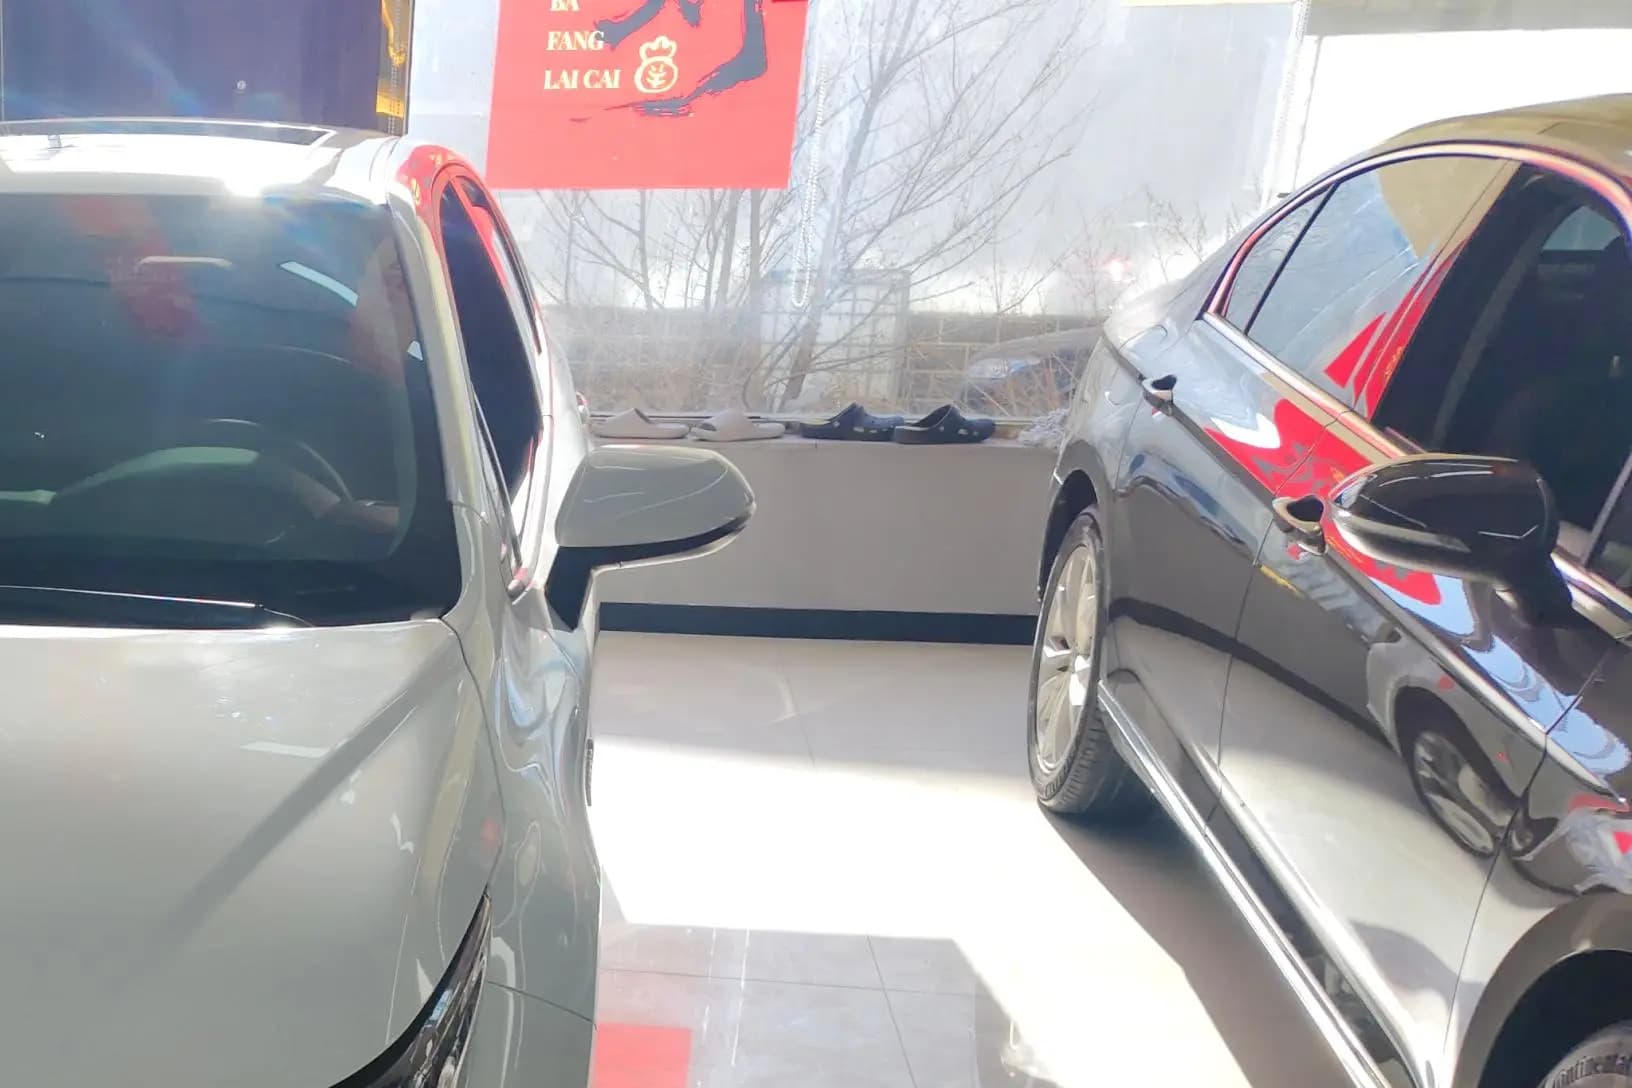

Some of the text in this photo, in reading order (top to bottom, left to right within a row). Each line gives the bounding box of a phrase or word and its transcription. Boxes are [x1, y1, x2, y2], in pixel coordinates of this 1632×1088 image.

[546, 30, 605, 51] FANG
[544, 69, 622, 90] LAI CAI
